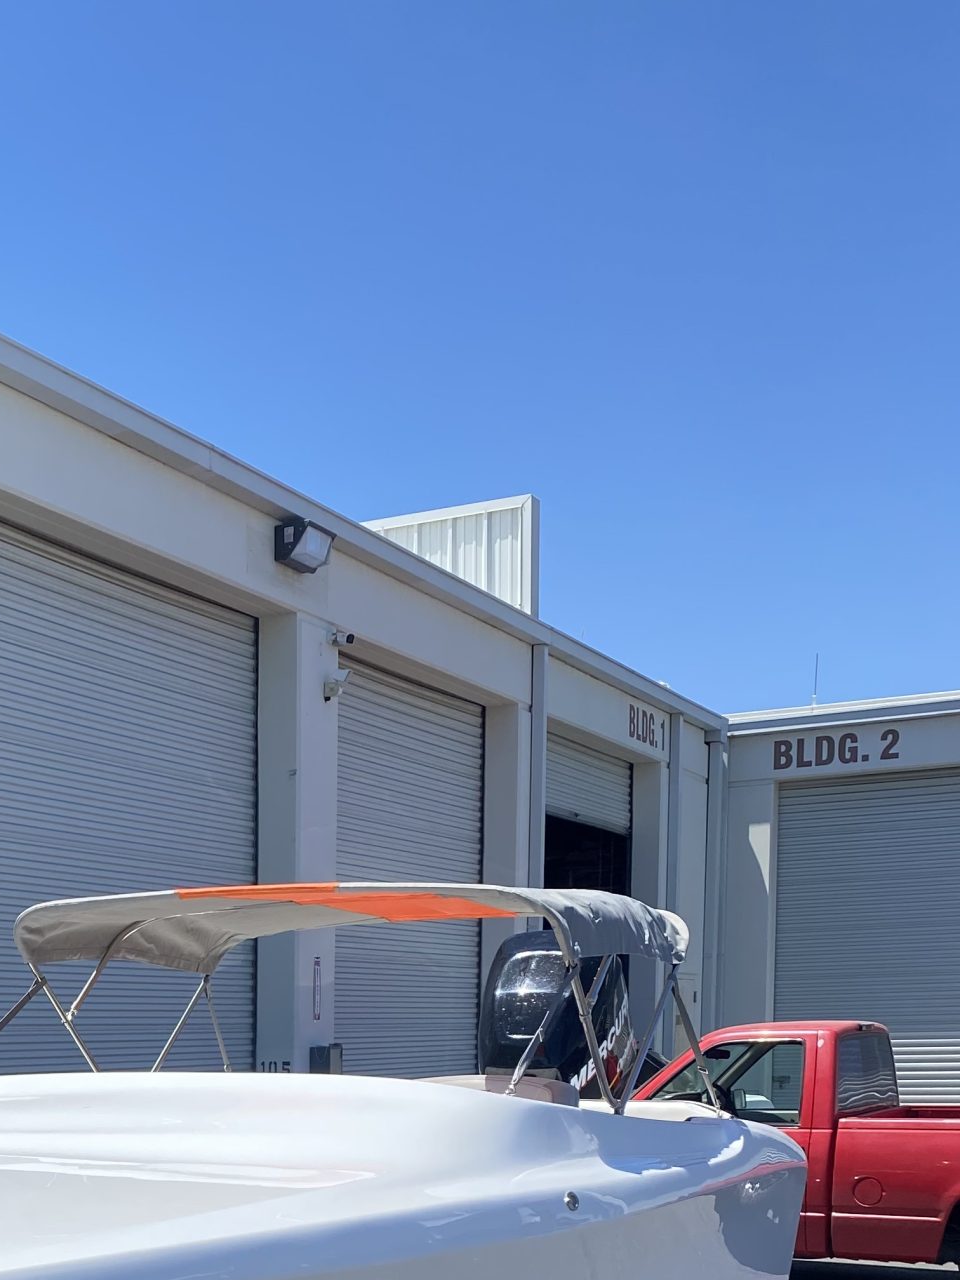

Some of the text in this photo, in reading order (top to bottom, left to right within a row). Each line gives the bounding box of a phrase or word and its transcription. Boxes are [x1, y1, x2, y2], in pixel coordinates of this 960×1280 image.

[629, 703, 666, 752] BLDG. 1
[773, 728, 900, 770] BLDG. 2
[570, 993, 629, 1091] MERCUR
